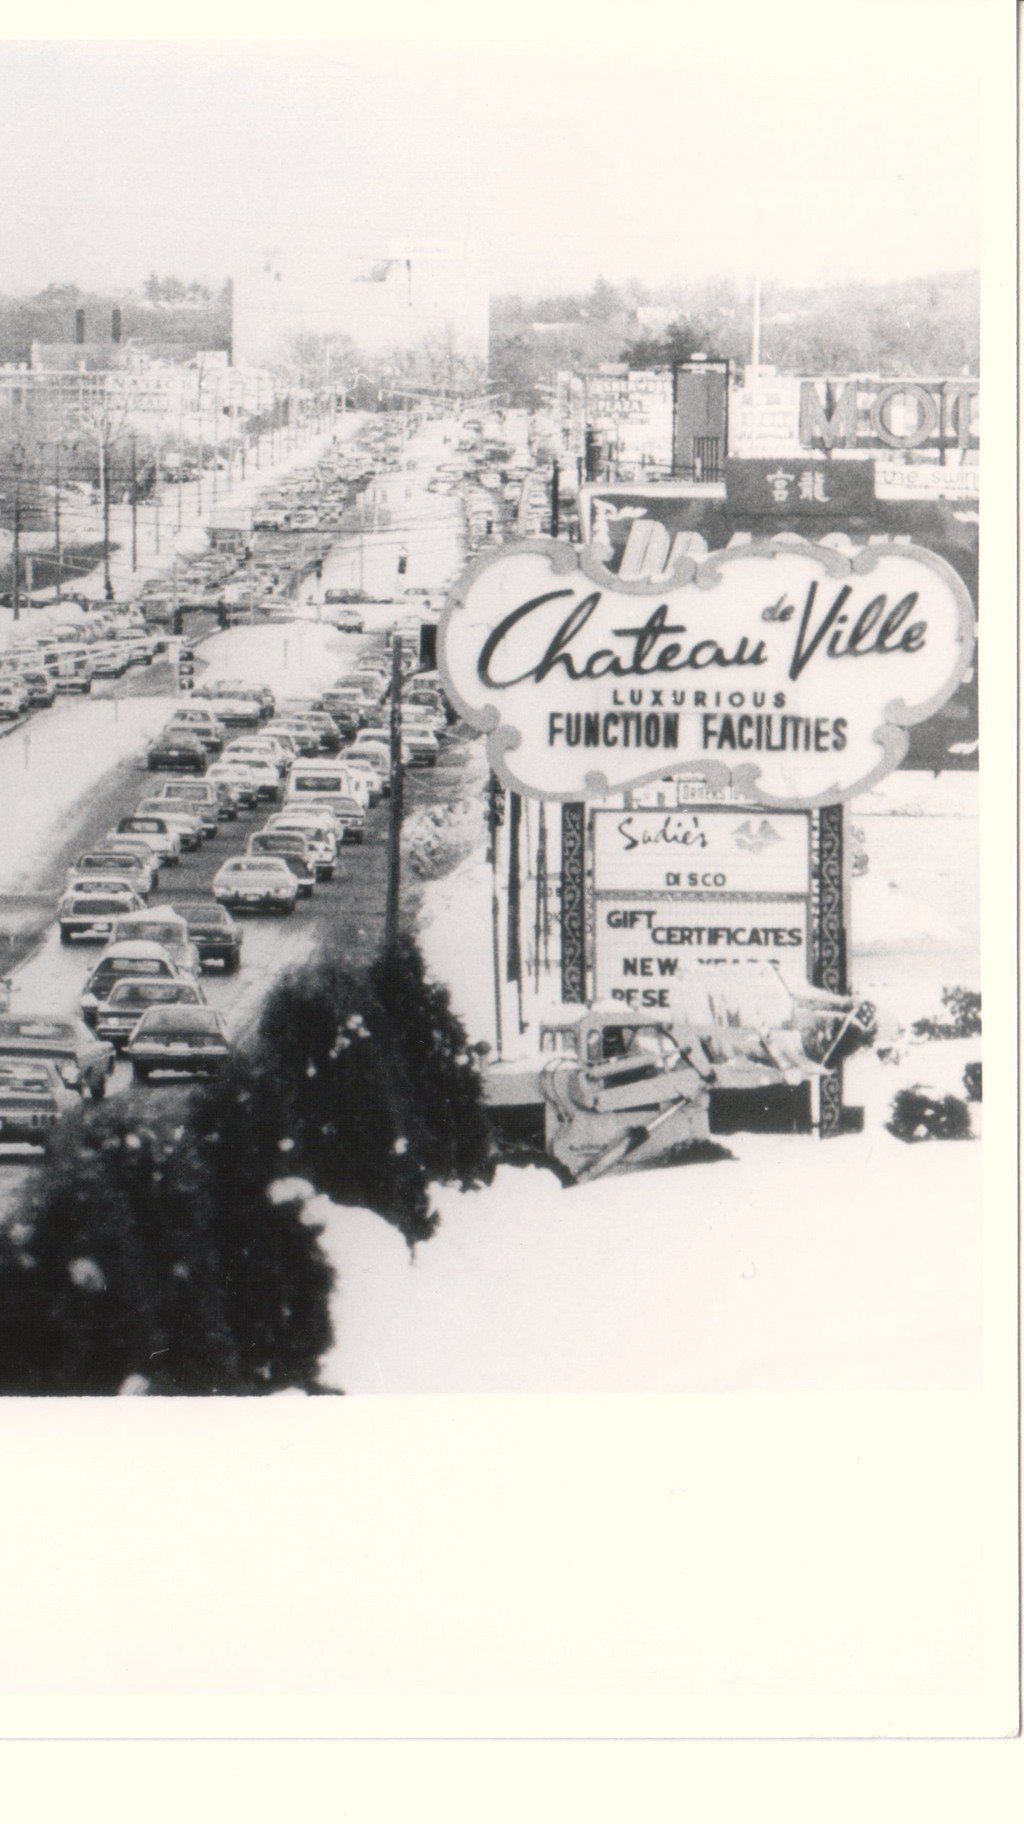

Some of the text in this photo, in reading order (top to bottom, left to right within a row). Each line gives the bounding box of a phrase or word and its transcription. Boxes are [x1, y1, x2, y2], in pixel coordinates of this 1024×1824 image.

[476, 580, 929, 690] Chateau de Ville
[612, 689, 788, 709] LUXURIOUS
[548, 711, 849, 752] FUNCTION FACILITIES
[617, 815, 709, 851] Sadie's
[606, 910, 657, 929] GIFT
[651, 926, 804, 947] CERTIFICATES
[622, 957, 679, 977] NEW
